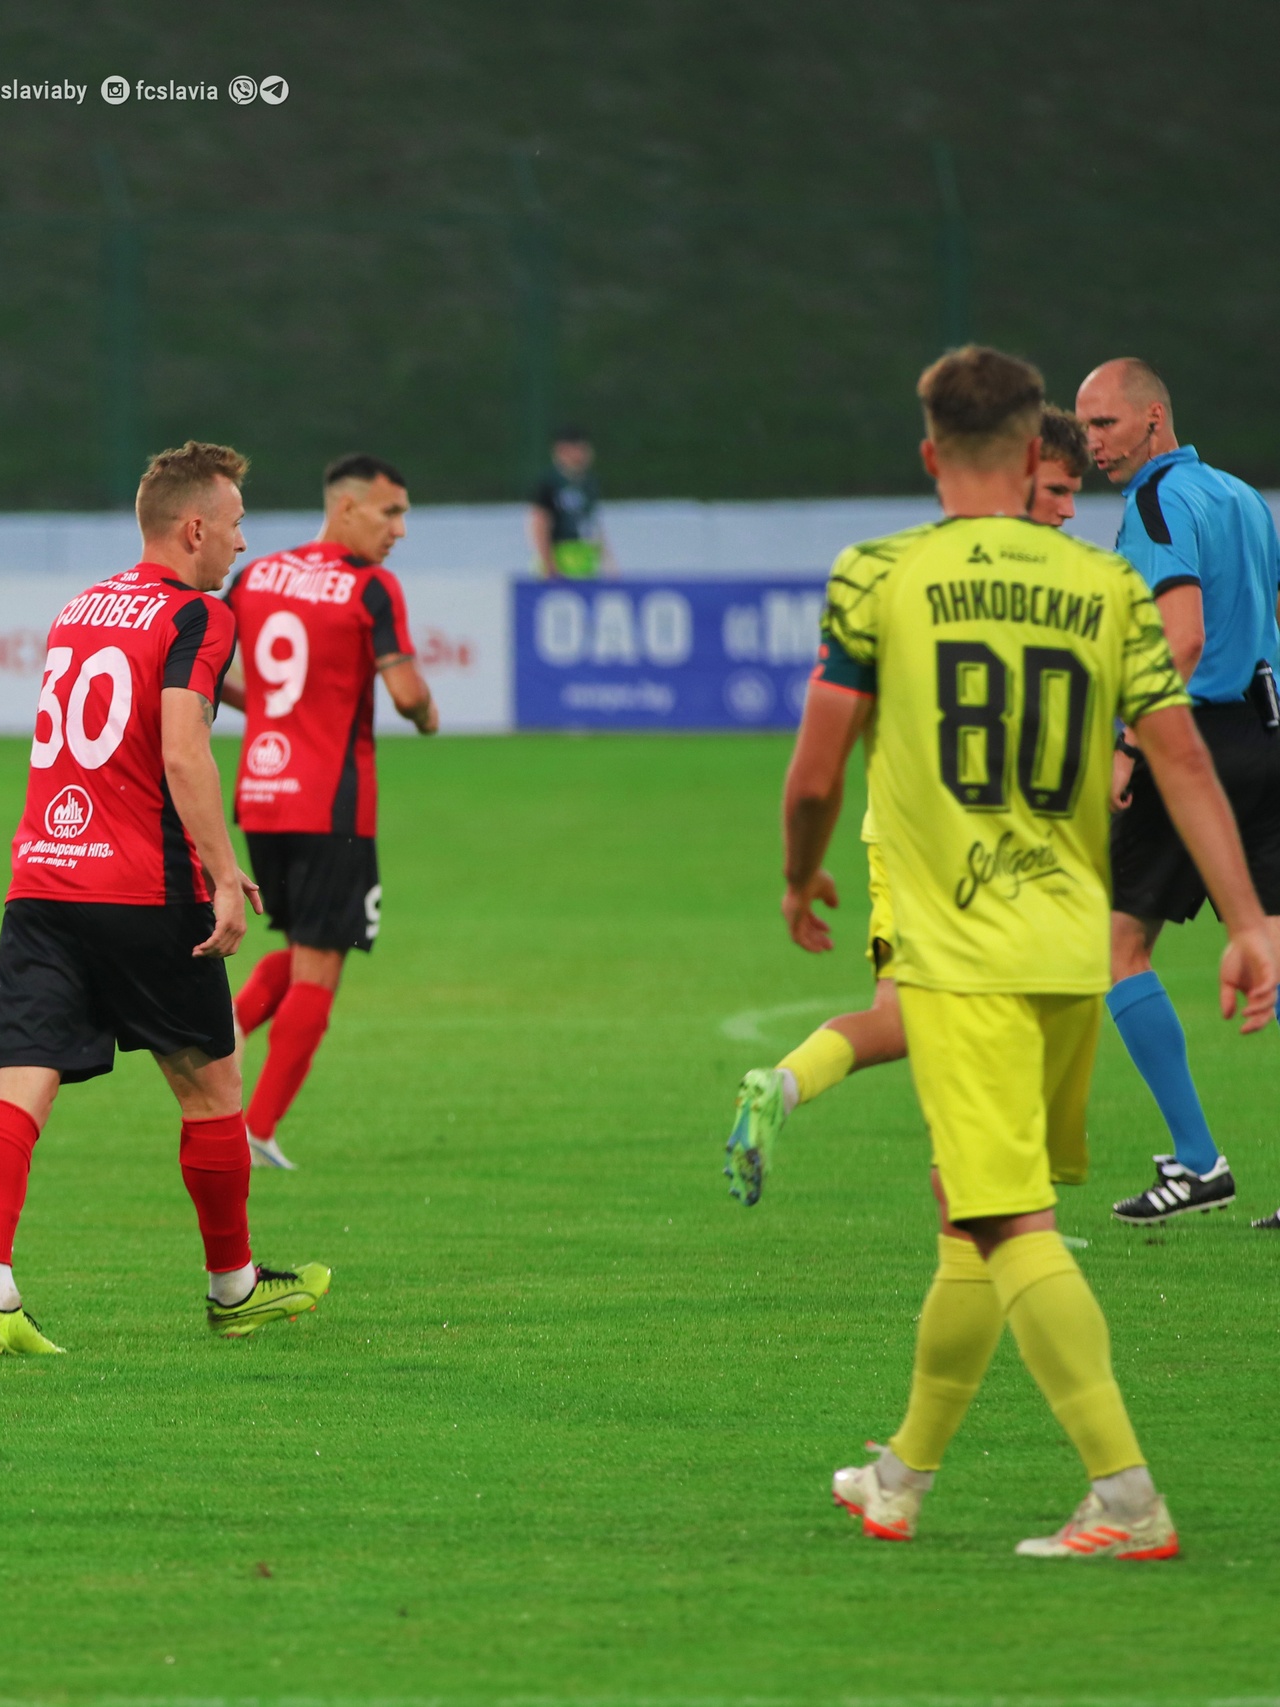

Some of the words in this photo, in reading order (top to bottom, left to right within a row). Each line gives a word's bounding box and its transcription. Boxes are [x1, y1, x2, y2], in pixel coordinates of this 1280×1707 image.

[55, 592, 170, 631] СОЛОВЕЙ
[535, 589, 693, 668] ОАО
[926, 580, 1105, 641] ЯНКОВСКИЙ
[30, 645, 133, 770] 30
[254, 610, 310, 719] 9
[935, 640, 1094, 819] 80
